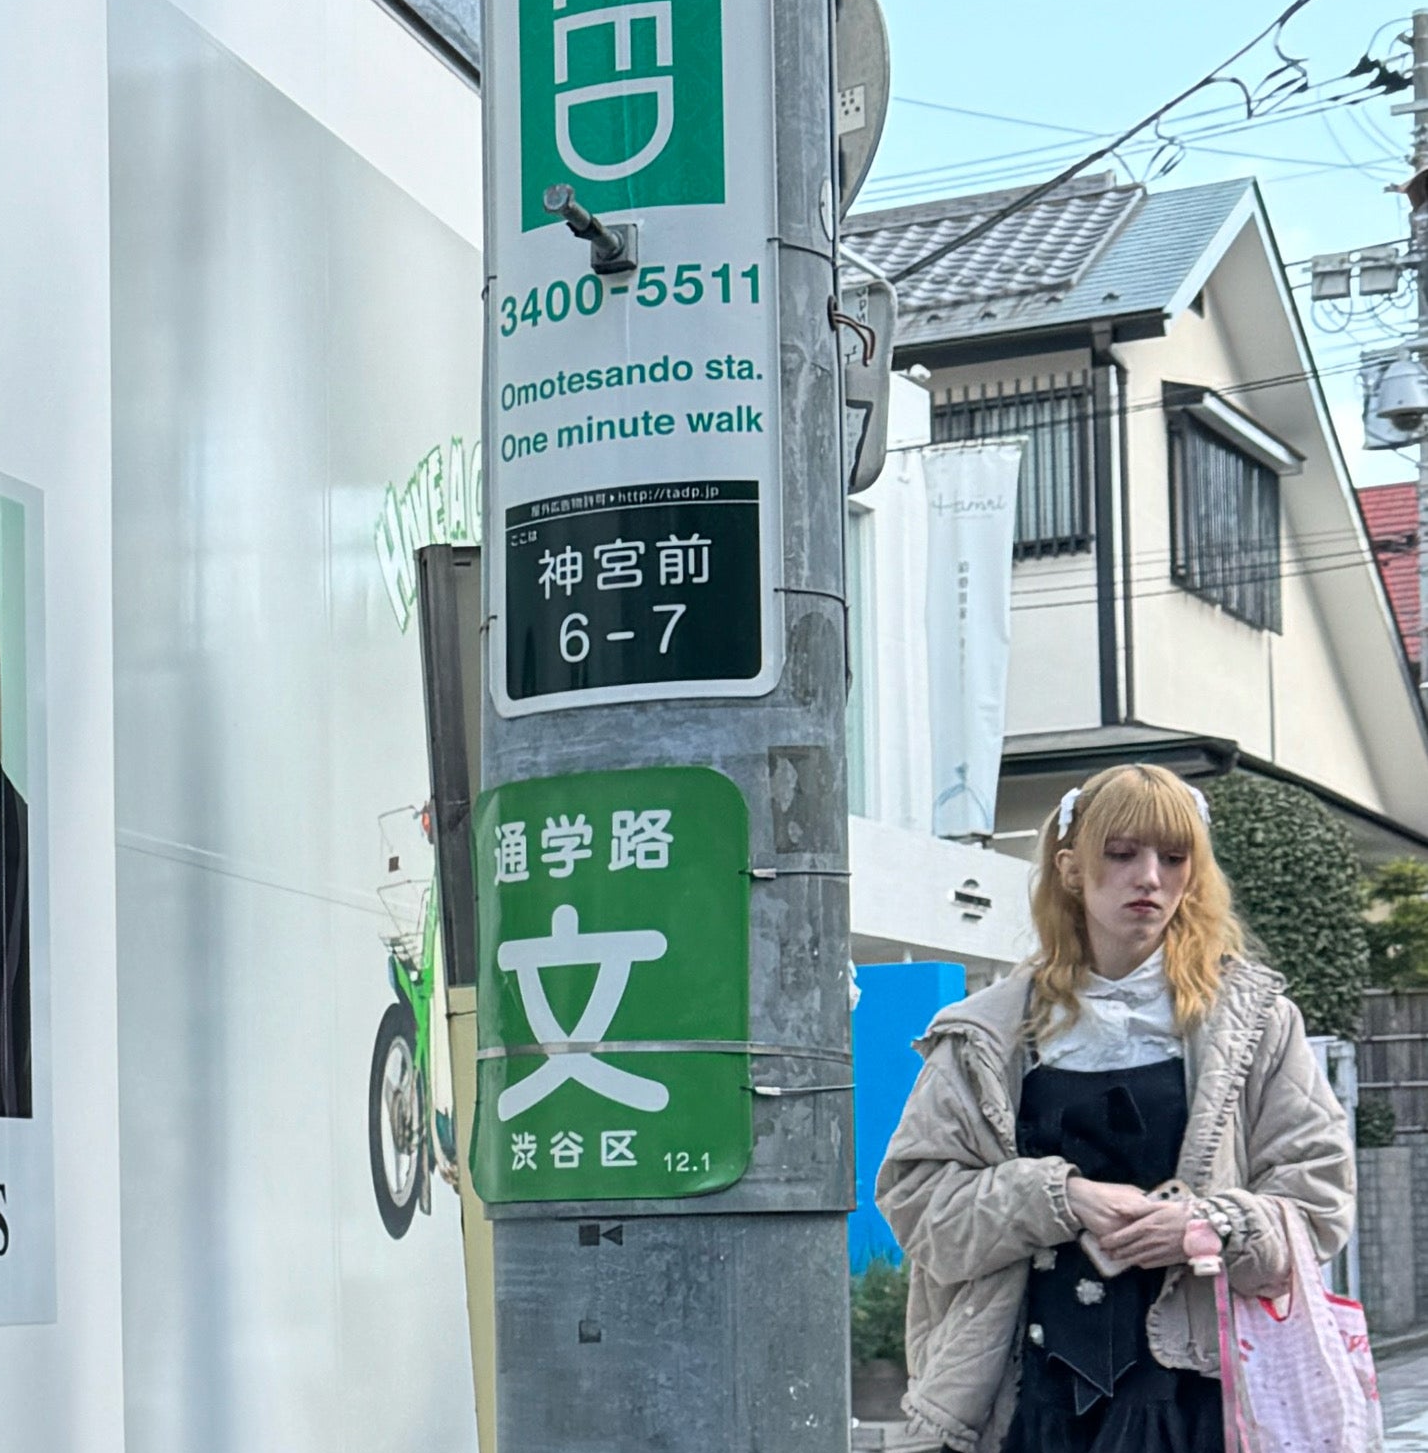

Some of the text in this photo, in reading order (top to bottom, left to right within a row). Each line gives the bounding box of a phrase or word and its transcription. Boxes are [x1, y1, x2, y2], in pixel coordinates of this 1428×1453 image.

[500, 263, 761, 337] 3400-5511
[501, 354, 763, 411] Omotesando sta.
[501, 405, 764, 462] One minute walk
[538, 533, 712, 600] 神宮前
[494, 809, 673, 886] 通学路
[497, 904, 670, 1122] 文
[511, 1130, 711, 1173] 渋谷区 12.1
